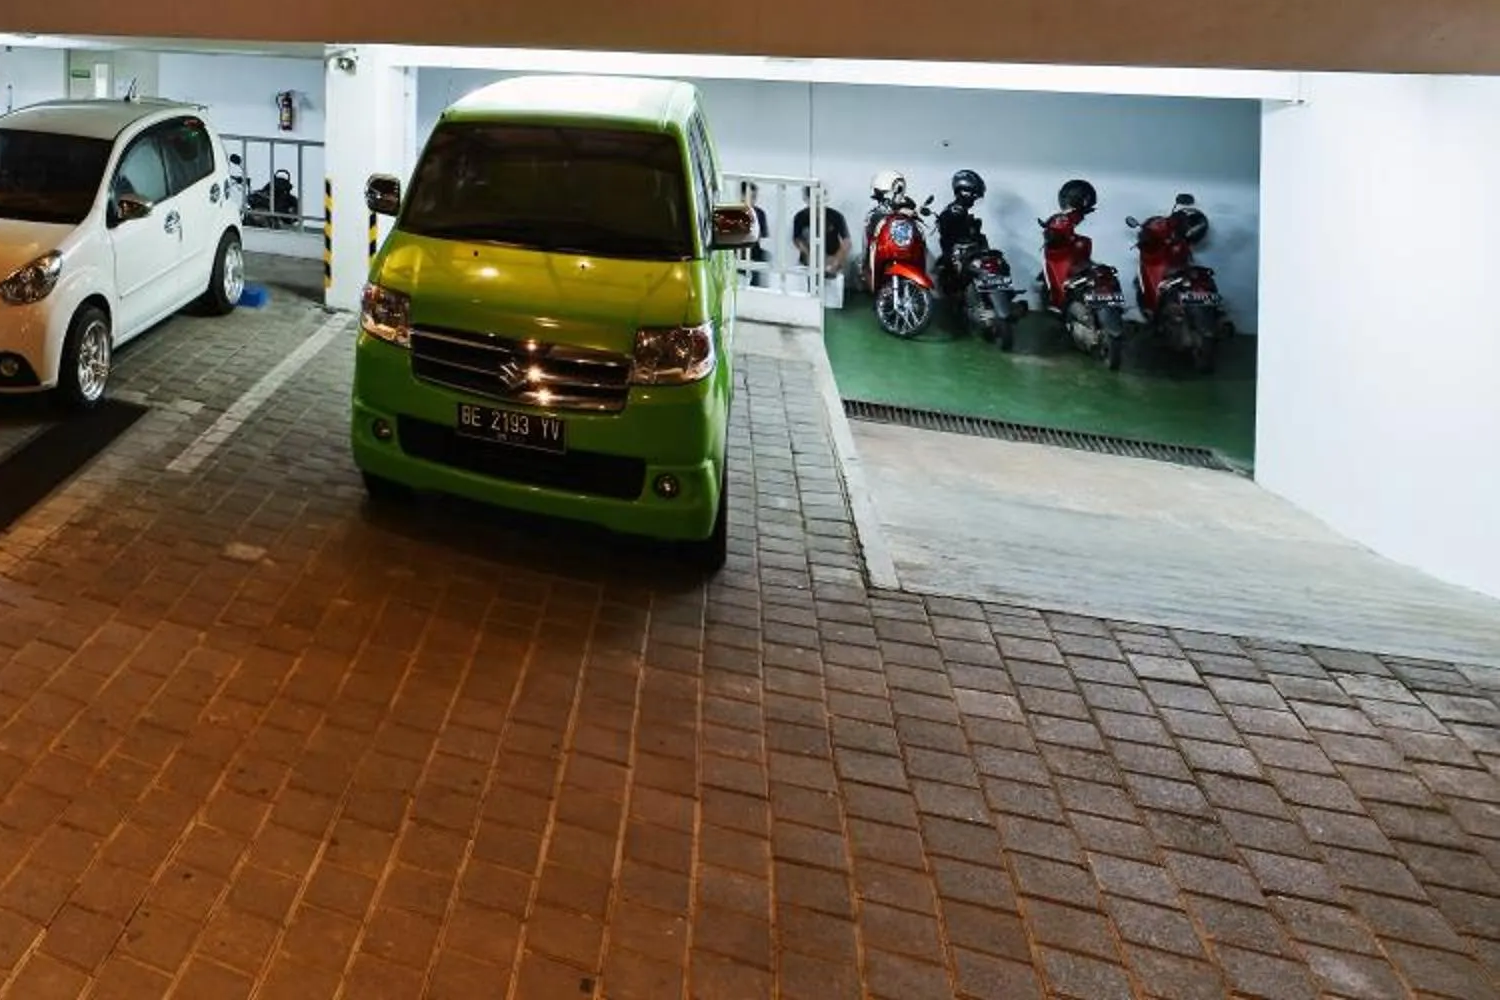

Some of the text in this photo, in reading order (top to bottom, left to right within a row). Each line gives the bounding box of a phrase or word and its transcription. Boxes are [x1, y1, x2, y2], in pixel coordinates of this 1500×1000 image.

[461, 405, 482, 427] BE
[491, 411, 529, 435] 2193
[541, 418, 560, 441] YV
